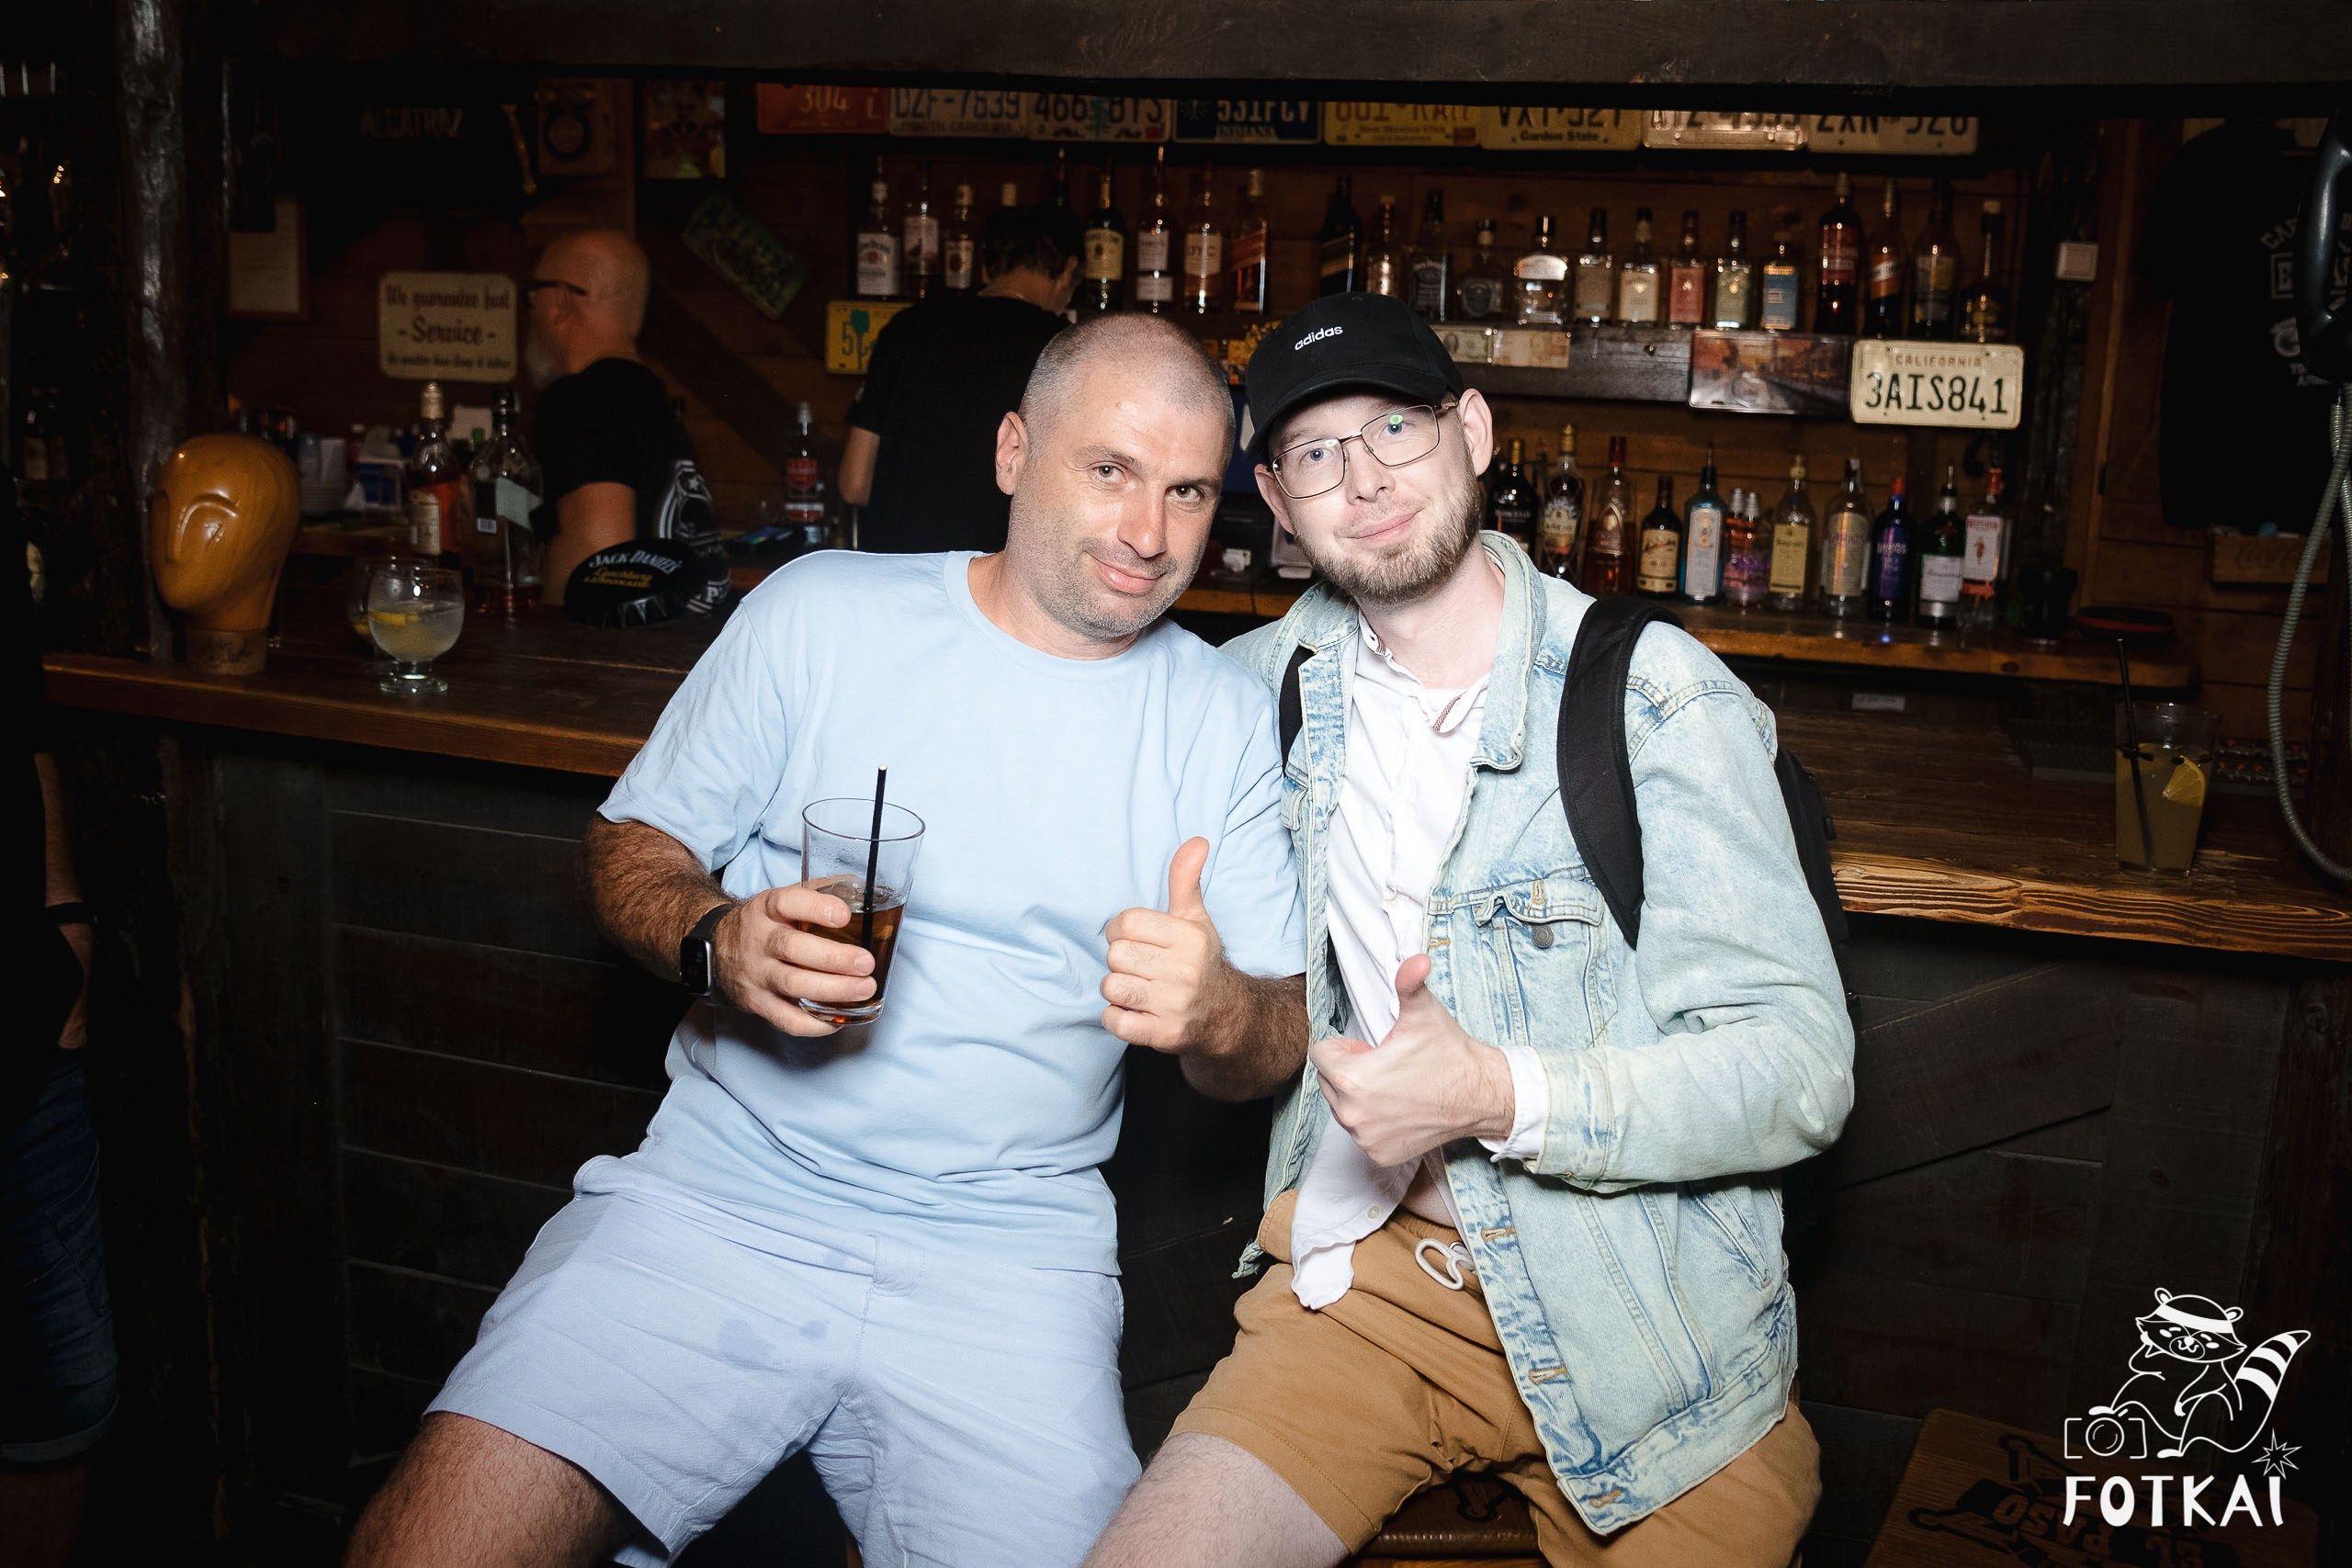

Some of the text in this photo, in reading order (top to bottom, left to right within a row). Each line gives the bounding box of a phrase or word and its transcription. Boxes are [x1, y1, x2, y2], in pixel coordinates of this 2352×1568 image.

[1520, 130, 1599, 142] Garden State
[412, 314, 483, 345] Service
[1295, 326, 1343, 350] adidas
[1894, 354, 1983, 368] CALIFORNIA
[1865, 371, 2008, 414] 3AIS841
[588, 548, 683, 575] JACK DANIEL'S
[1992, 1493, 2113, 1562] PASO
